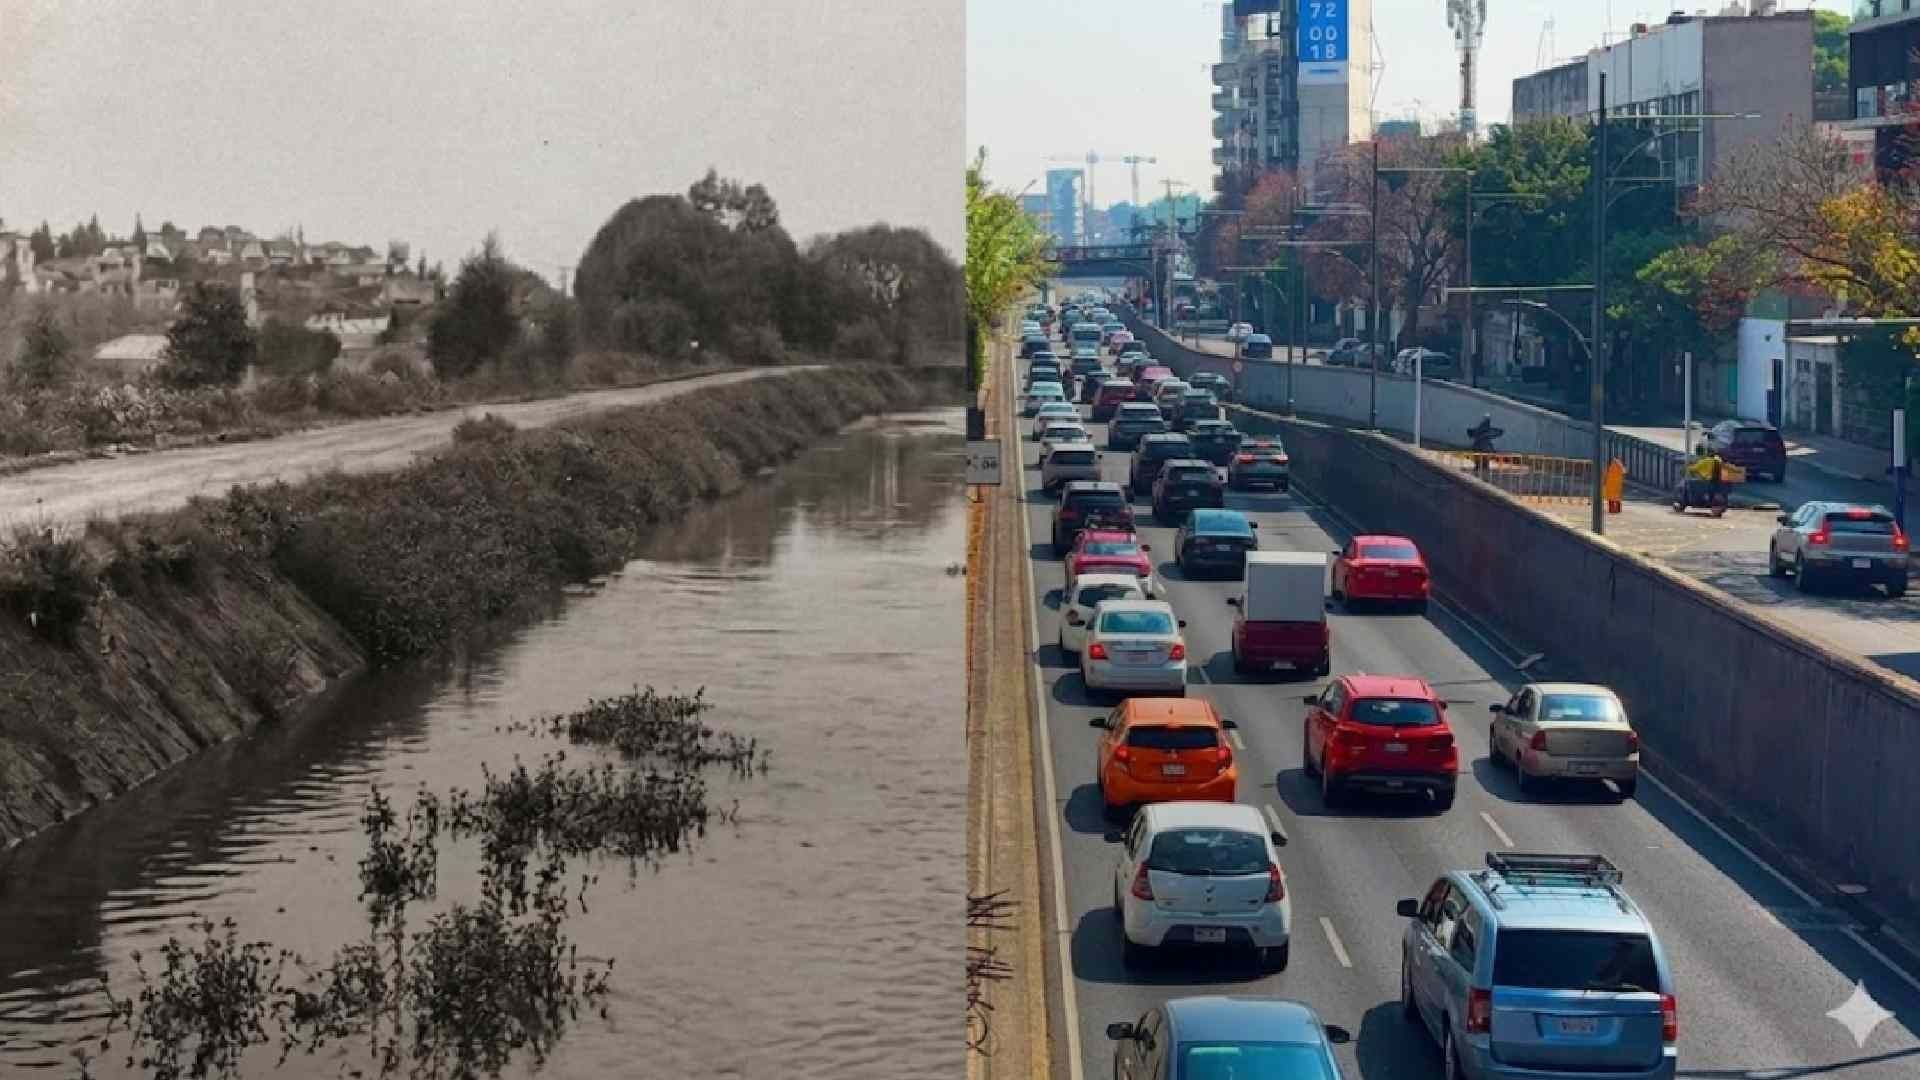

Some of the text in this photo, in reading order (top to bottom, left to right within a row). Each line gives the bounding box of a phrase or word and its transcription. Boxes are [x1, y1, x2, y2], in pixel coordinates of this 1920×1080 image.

[1310, 2, 1337, 18] 72
[1310, 26, 1337, 41] 00
[1310, 44, 1337, 59] 18
